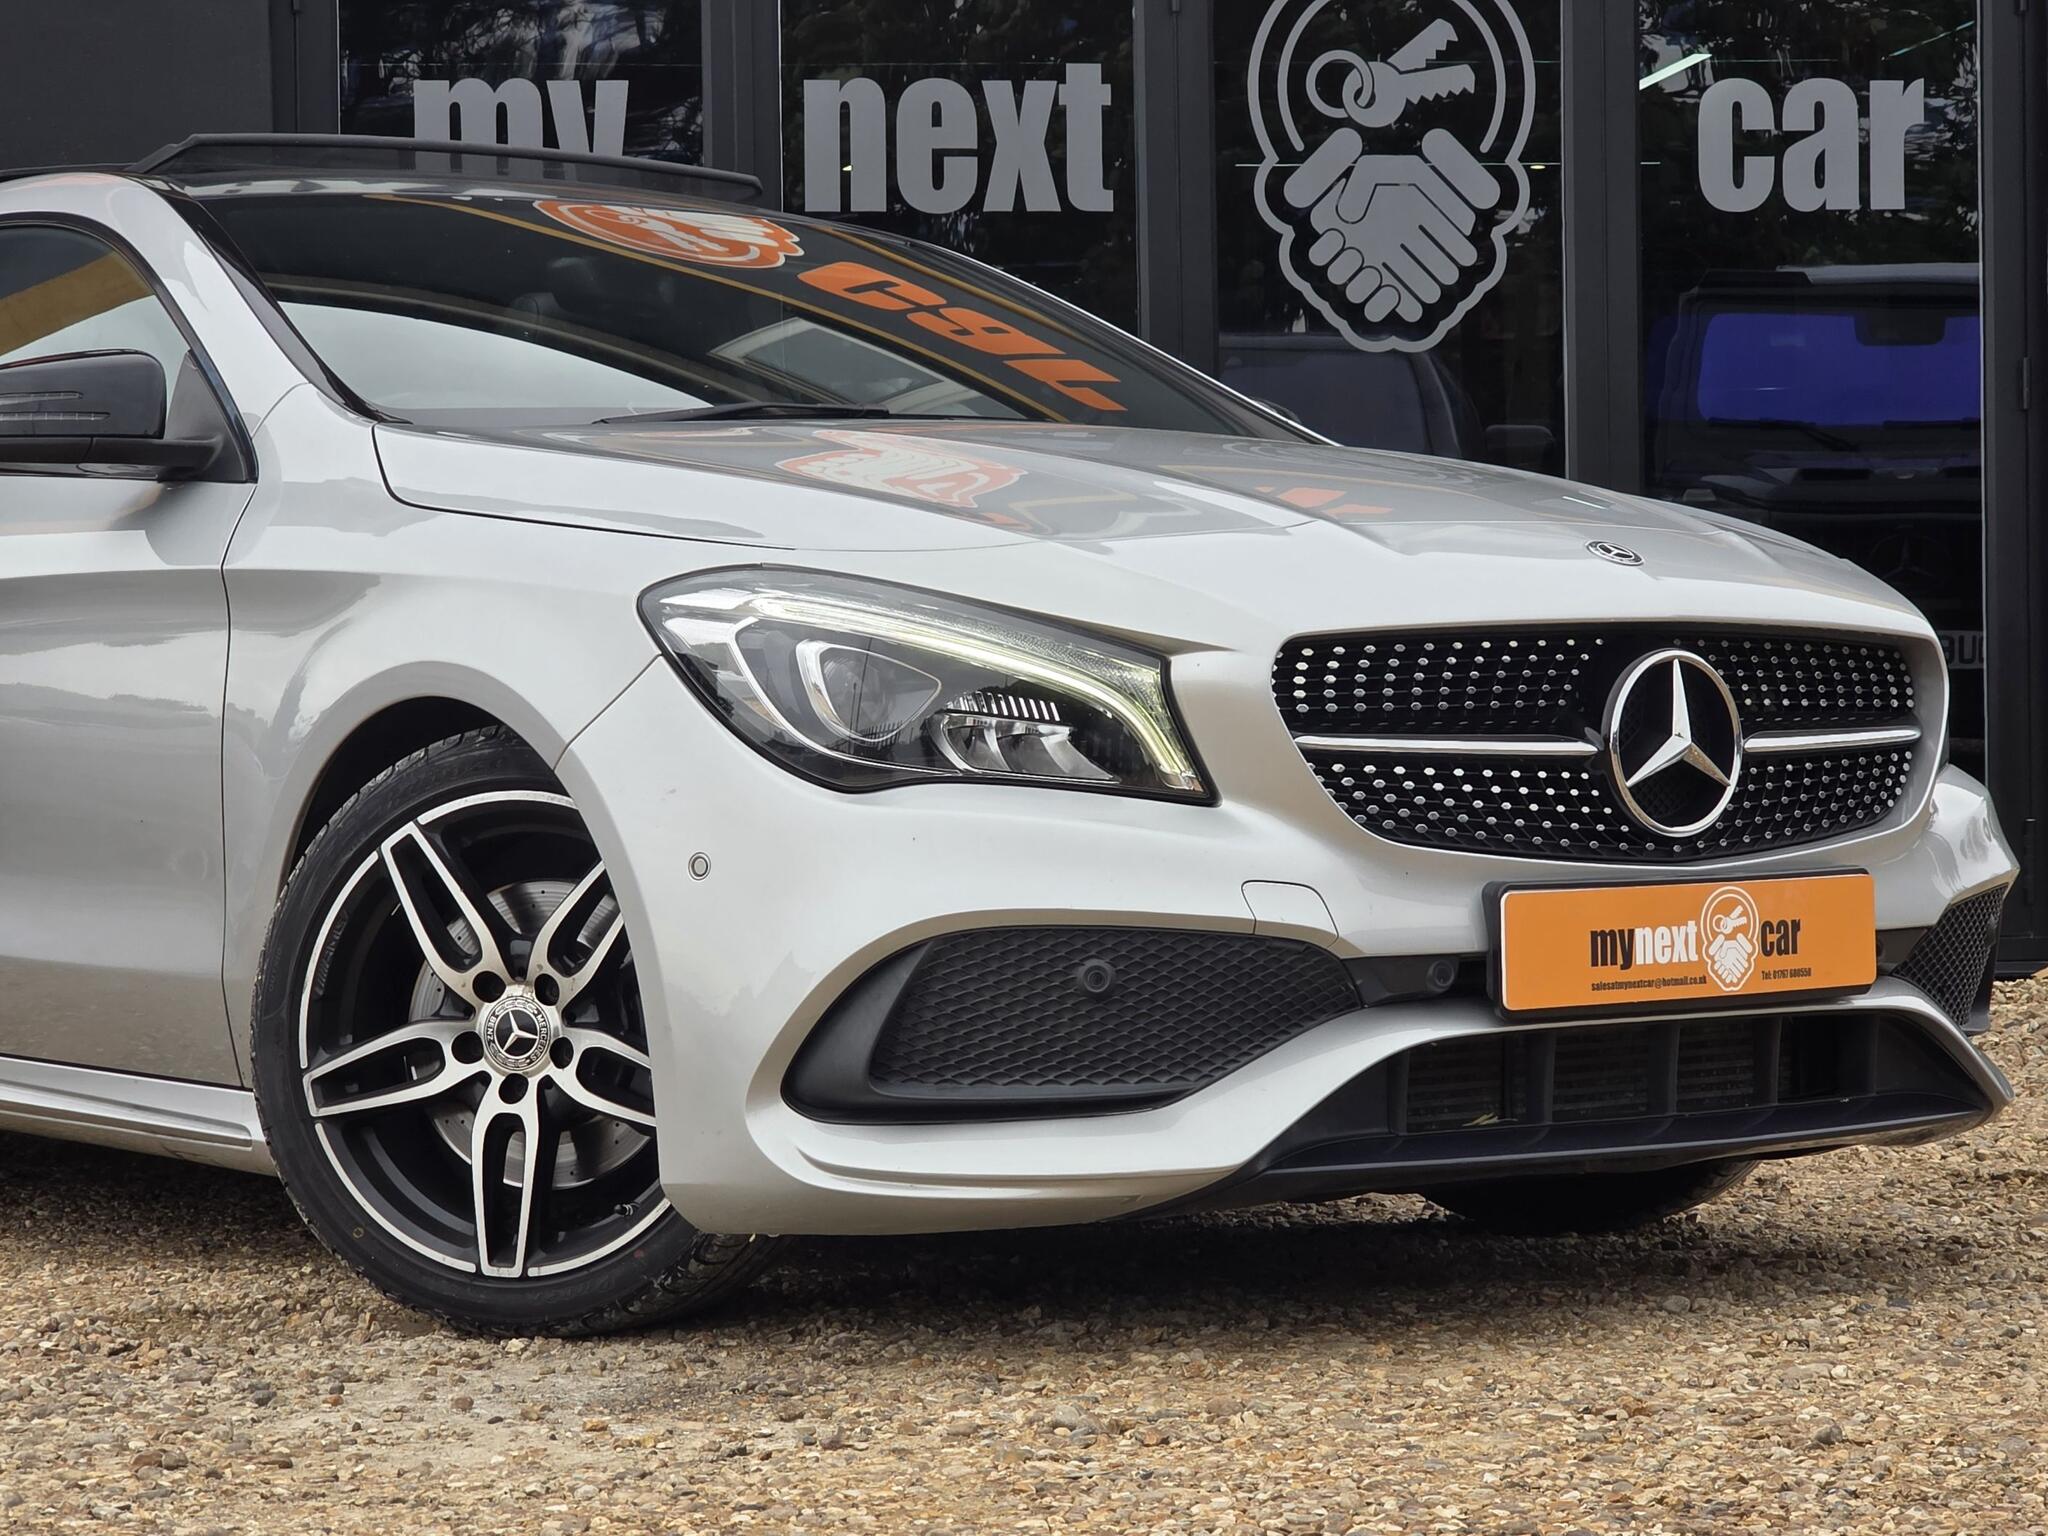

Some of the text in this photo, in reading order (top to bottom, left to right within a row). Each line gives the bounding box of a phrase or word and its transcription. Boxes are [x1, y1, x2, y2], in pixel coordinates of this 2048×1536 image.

[803, 64, 1114, 213] next
[1698, 77, 1925, 213] car
[1589, 917, 1801, 970] mynext car
[486, 1015, 497, 1042] BENZ
[529, 1013, 548, 1061] MERCEDES
